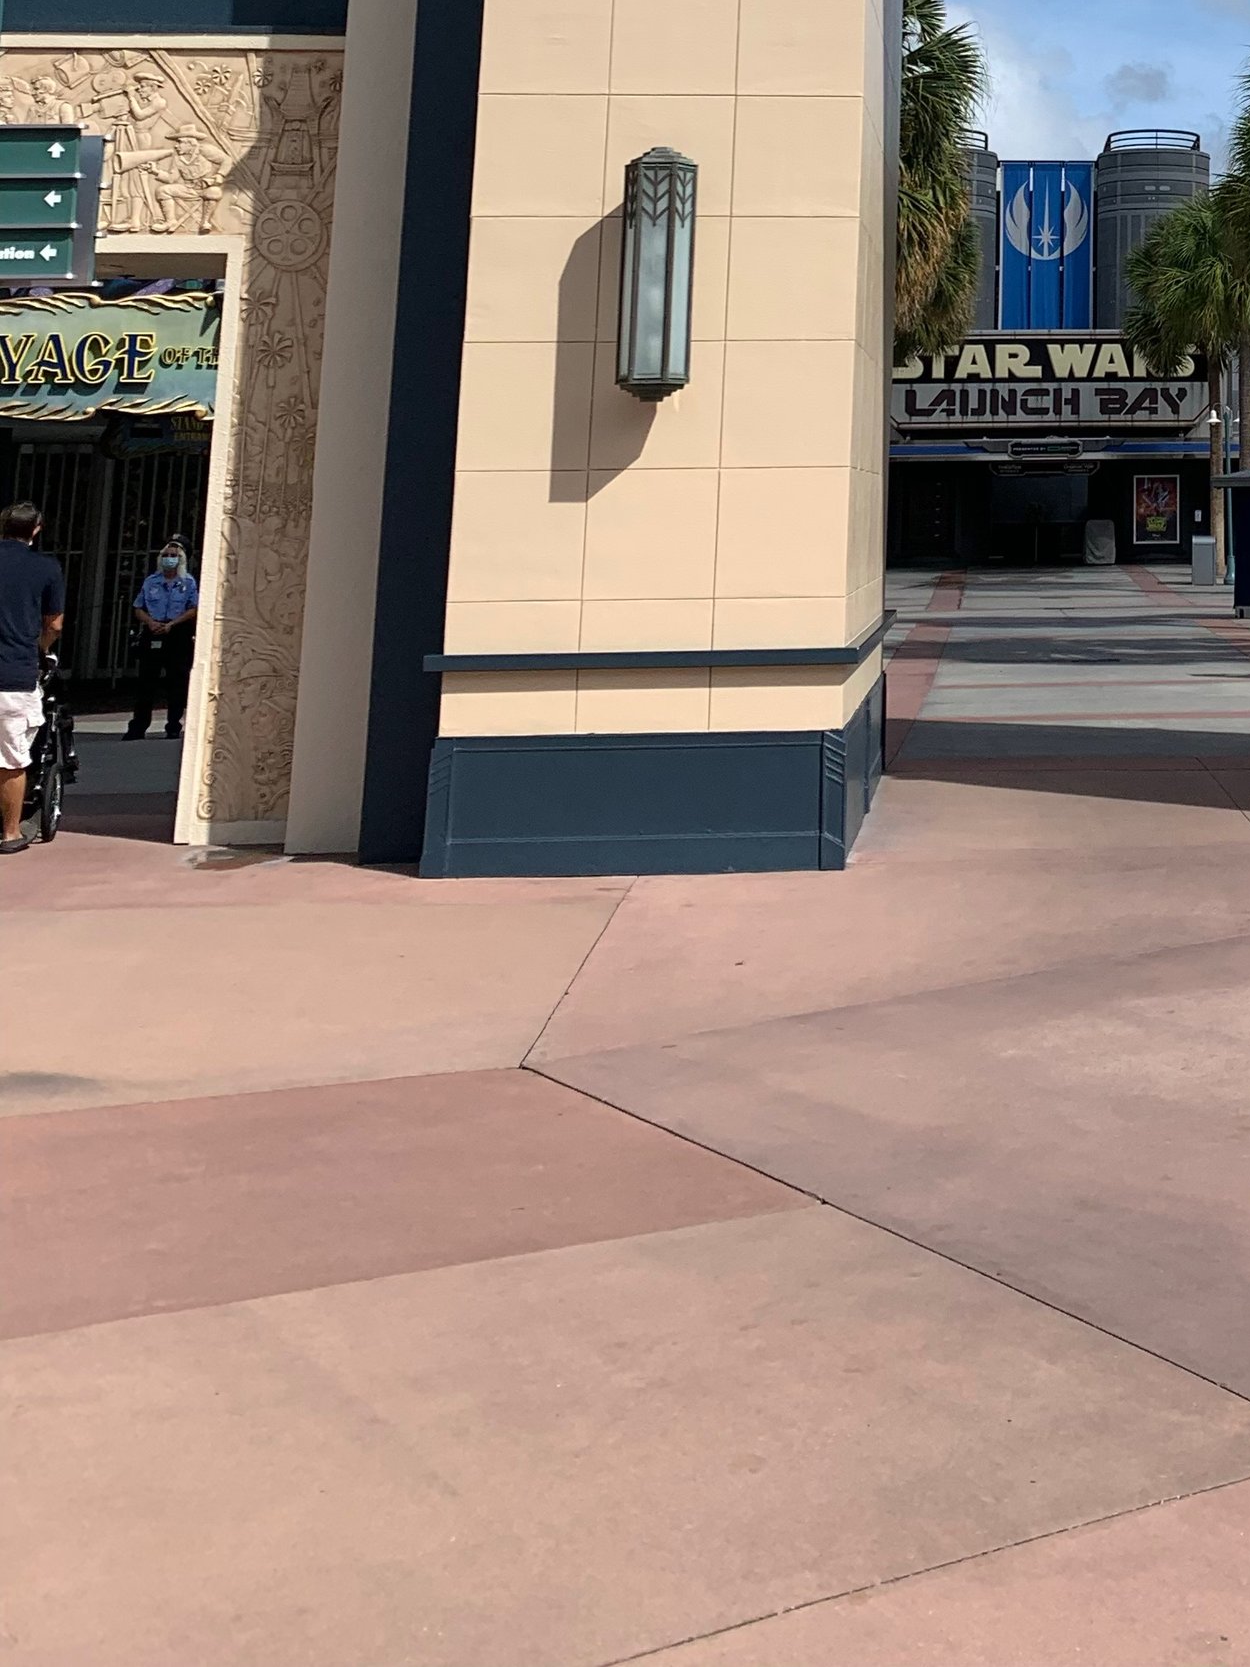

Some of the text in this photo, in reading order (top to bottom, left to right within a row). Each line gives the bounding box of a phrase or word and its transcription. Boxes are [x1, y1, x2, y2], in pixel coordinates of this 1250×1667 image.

[162, 345, 192, 365] OF
[193, 345, 219, 365] TH
[904, 387, 1188, 417] LAUNCH BAY
